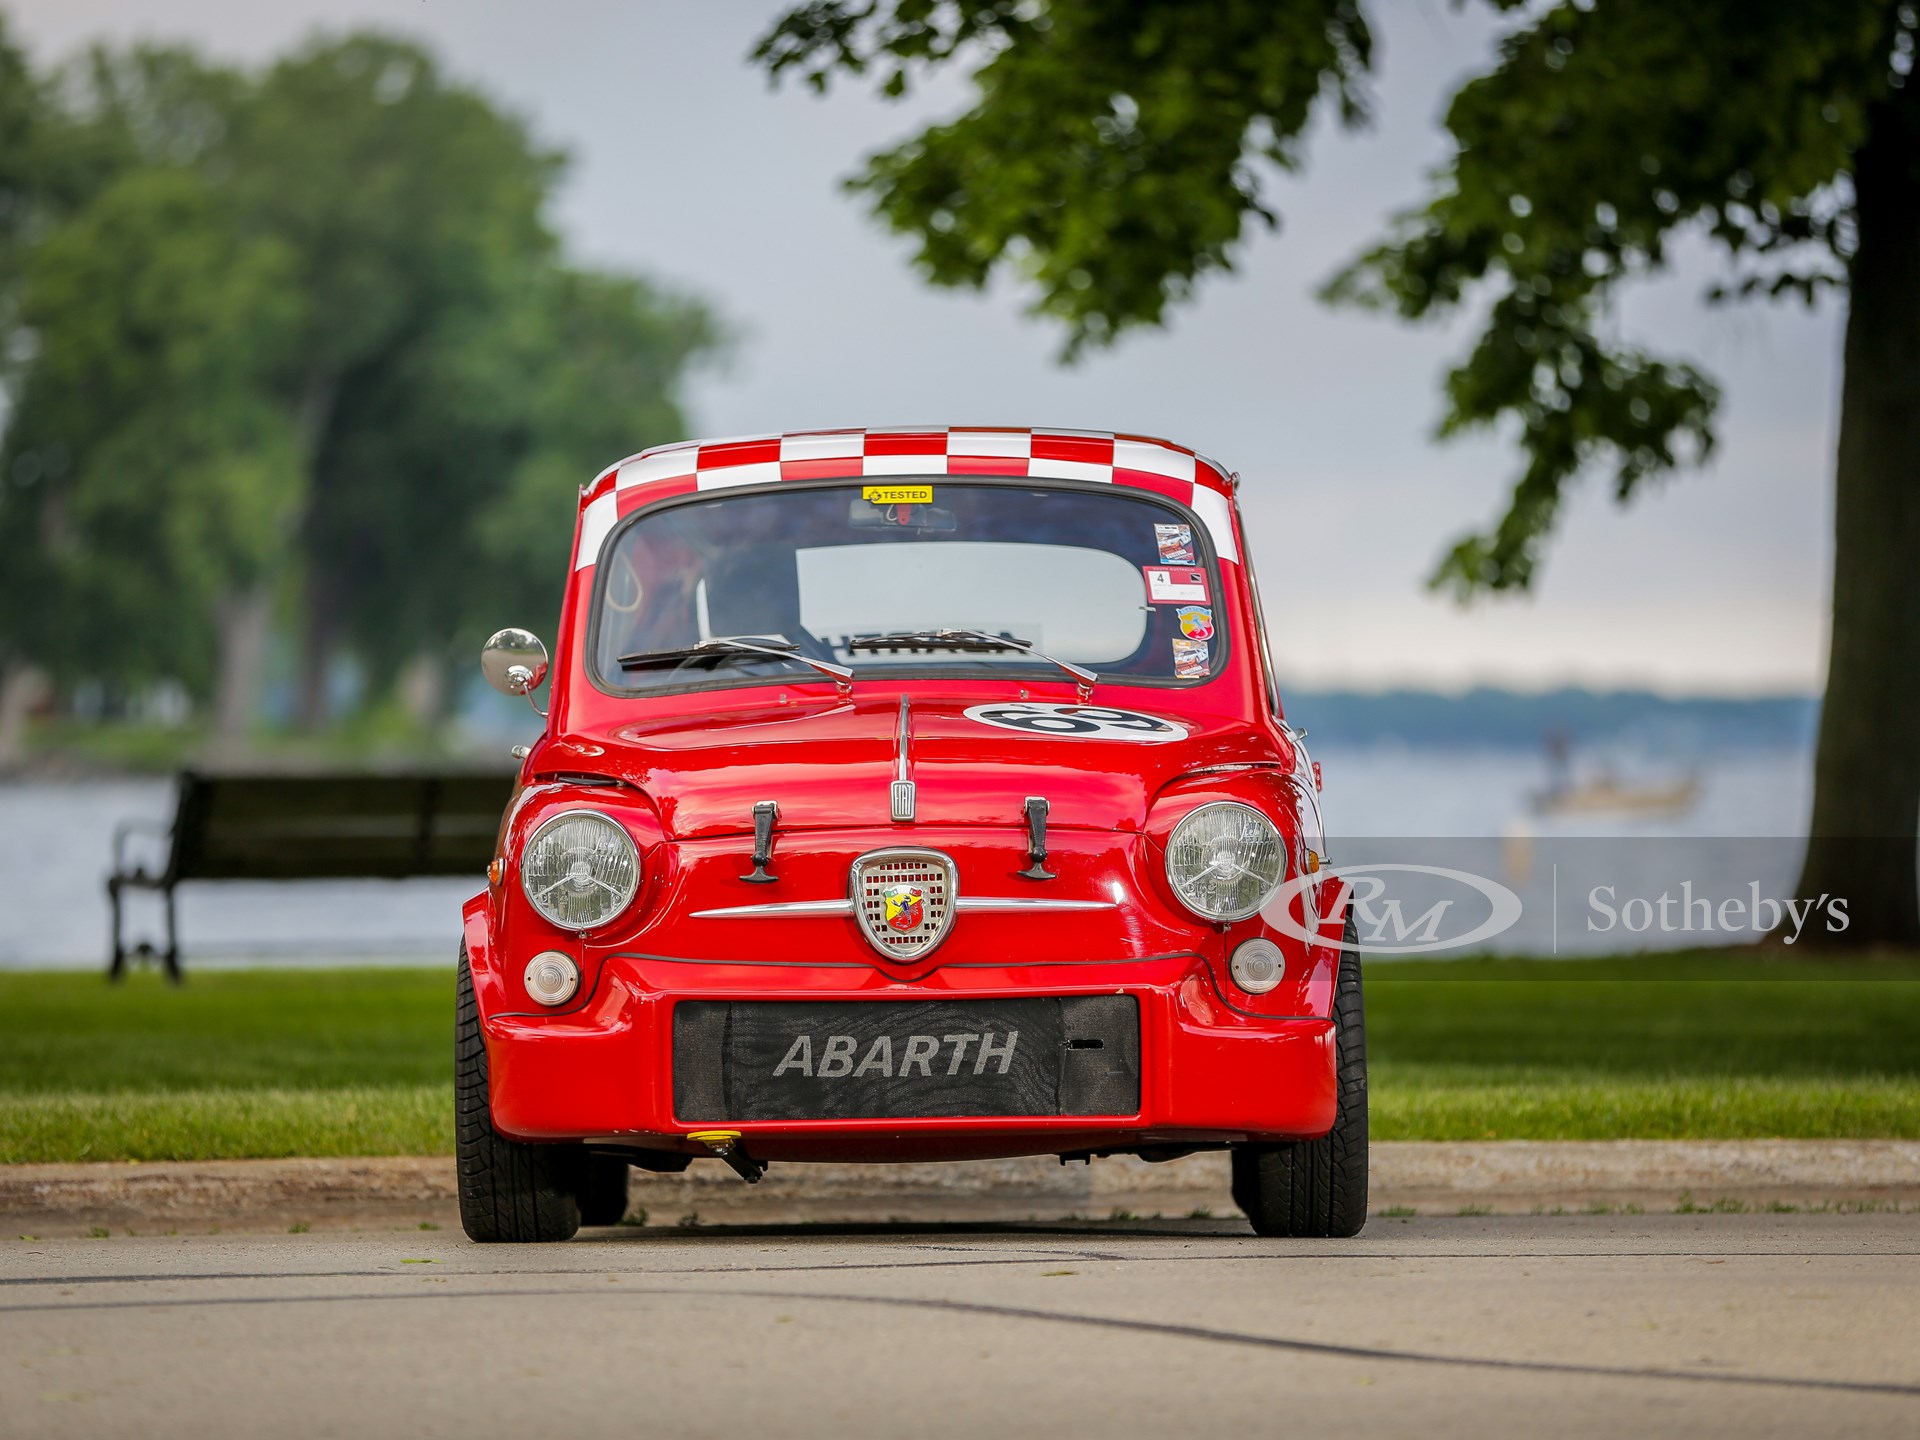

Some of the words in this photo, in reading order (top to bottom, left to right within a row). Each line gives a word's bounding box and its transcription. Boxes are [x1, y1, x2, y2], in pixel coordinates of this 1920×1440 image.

[884, 491, 927, 499] TESTED
[1157, 573, 1165, 584] 4
[980, 707, 1174, 733] 69
[894, 784, 913, 815] FIAT
[772, 1030, 1018, 1078] ABARTH
